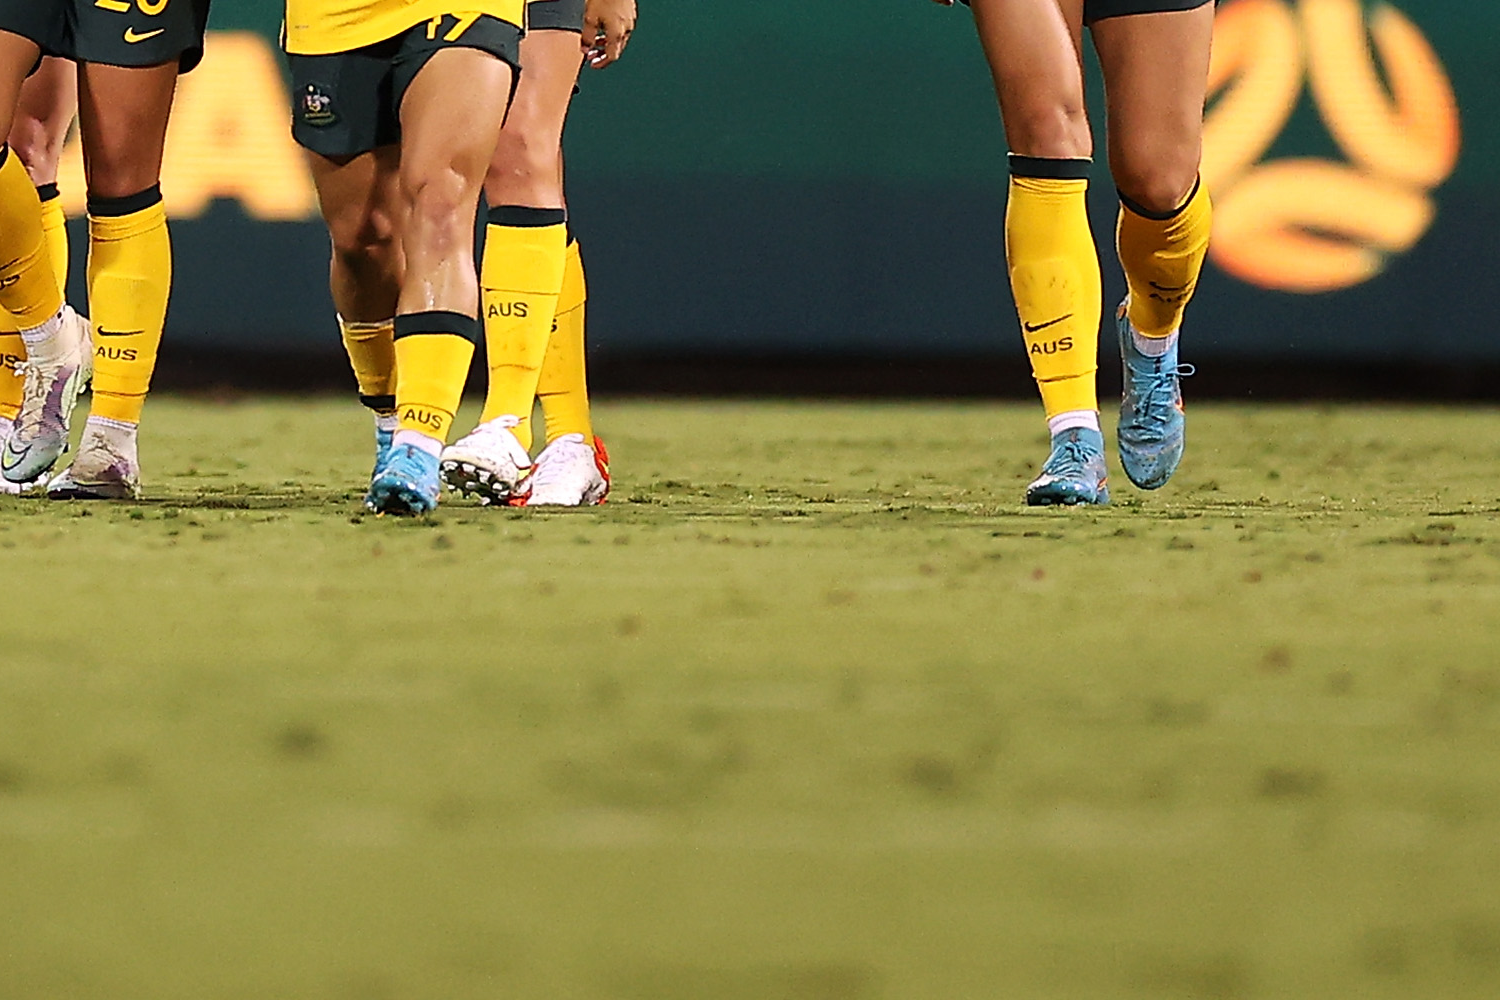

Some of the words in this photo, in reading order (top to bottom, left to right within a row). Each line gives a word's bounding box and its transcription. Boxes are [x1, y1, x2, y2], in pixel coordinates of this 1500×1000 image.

[488, 302, 529, 318] AUS
[95, 346, 137, 361] AUS
[1031, 337, 1073, 354] AUS
[404, 408, 443, 430] AUS
